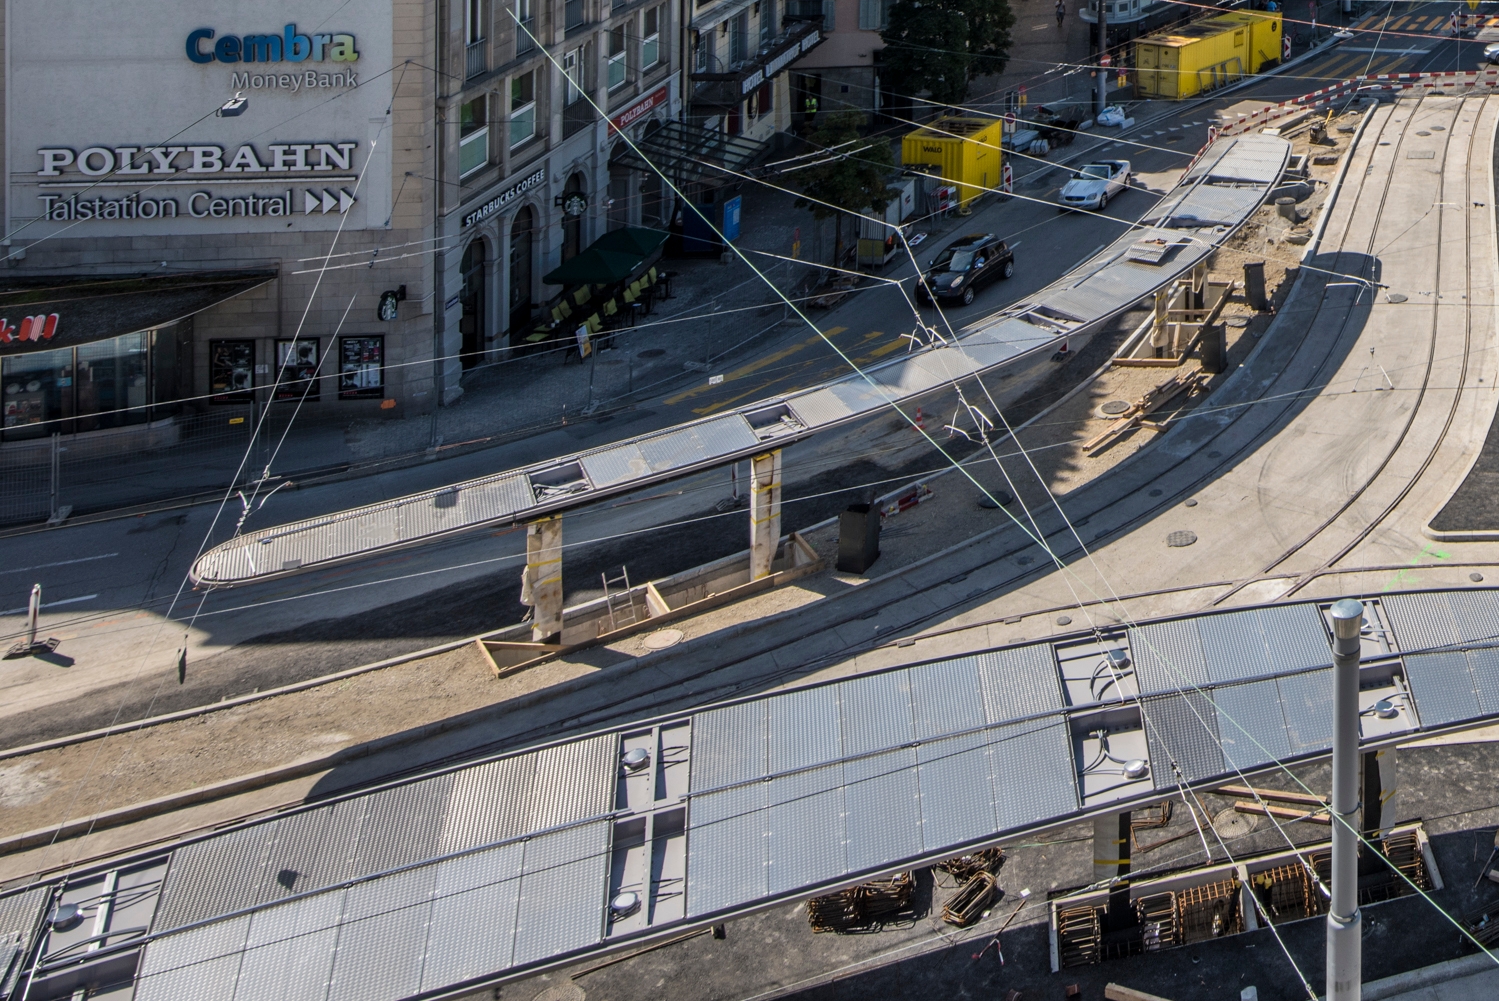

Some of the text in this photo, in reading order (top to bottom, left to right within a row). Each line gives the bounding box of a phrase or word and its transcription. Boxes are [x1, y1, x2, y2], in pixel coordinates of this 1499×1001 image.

[185, 23, 360, 64] Cembra
[231, 68, 359, 92] MoneyBank
[742, 69, 765, 95] HOTEL
[620, 96, 654, 126] POLYBAHN
[36, 142, 358, 177] POLYBAHN
[923, 146, 943, 154] WALO
[37, 188, 293, 221] Talstation Central
[465, 168, 545, 227] STARBUCKS COFFEE
